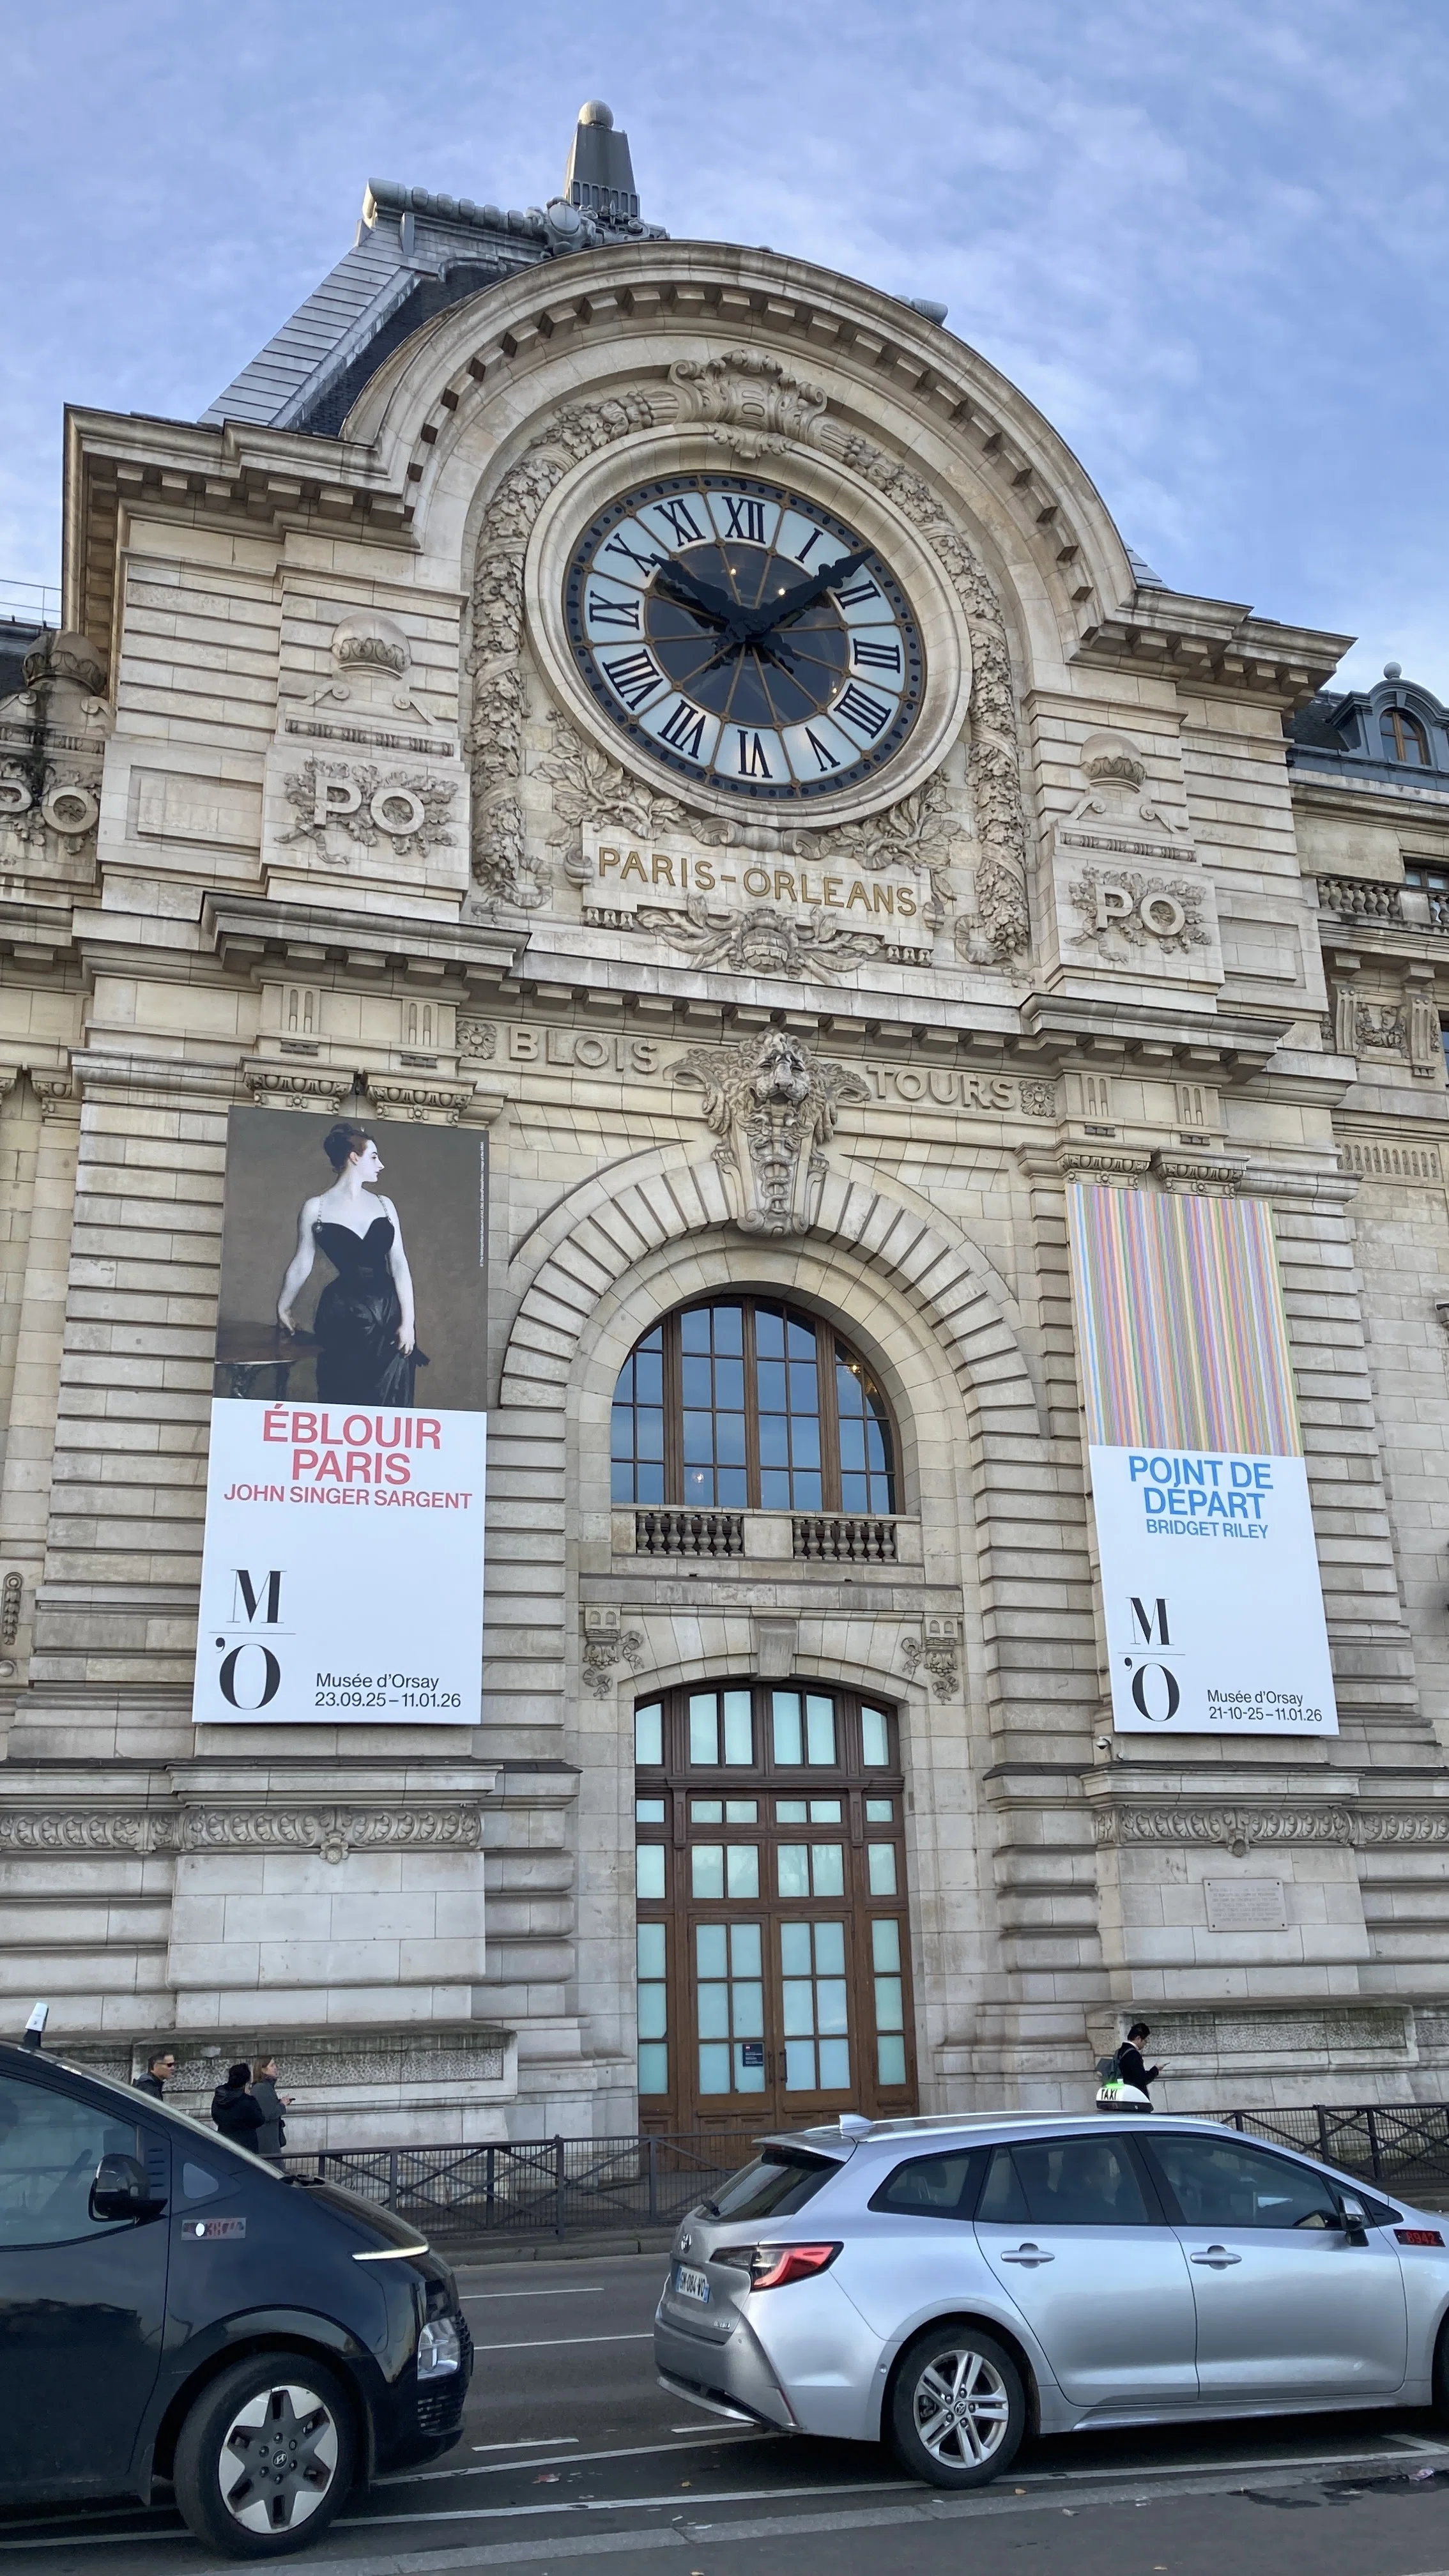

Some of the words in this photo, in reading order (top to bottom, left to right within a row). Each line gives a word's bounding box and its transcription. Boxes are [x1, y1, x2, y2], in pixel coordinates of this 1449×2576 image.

[653, 498, 706, 546] XI
[721, 496, 766, 544] XII
[604, 533, 660, 577] X
[794, 527, 824, 564] I
[589, 590, 640, 631] IX
[834, 580, 881, 610] II
[853, 638, 901, 673] III
[601, 648, 664, 710] VIII
[657, 699, 707, 760] VII
[833, 683, 892, 739] IIII
[737, 730, 773, 778] VI
[805, 726, 840, 772] V
[314, 777, 425, 835] PO
[599, 846, 917, 916] PARIS-ORLEANS
[1094, 884, 1186, 937] PO
[509, 1023, 659, 1074] BLOIS
[866, 1064, 1016, 1110] TOURS
[263, 1403, 441, 1450] ÉBLOUIR
[292, 1449, 411, 1485] PARIS
[1128, 1455, 1223, 1487] POINT
[1230, 1461, 1274, 1489] DE
[224, 1484, 285, 1502] JOHN
[289, 1486, 370, 1506] SINGER
[374, 1489, 473, 1509] SARGENT
[1144, 1482, 1266, 1519] DÉPART
[1146, 1519, 1220, 1537] BRIDGET
[1222, 1522, 1269, 1539] RILEY
[226, 1569, 288, 1623] M
[1125, 1597, 1175, 1646] M
[316, 1673, 372, 1688] Musée
[377, 1673, 440, 1692] d'Orsay
[1207, 1689, 1252, 1703] Musée
[1255, 1690, 1303, 1707] d'Orsay
[1101, 2089, 1117, 2101] TAXI
